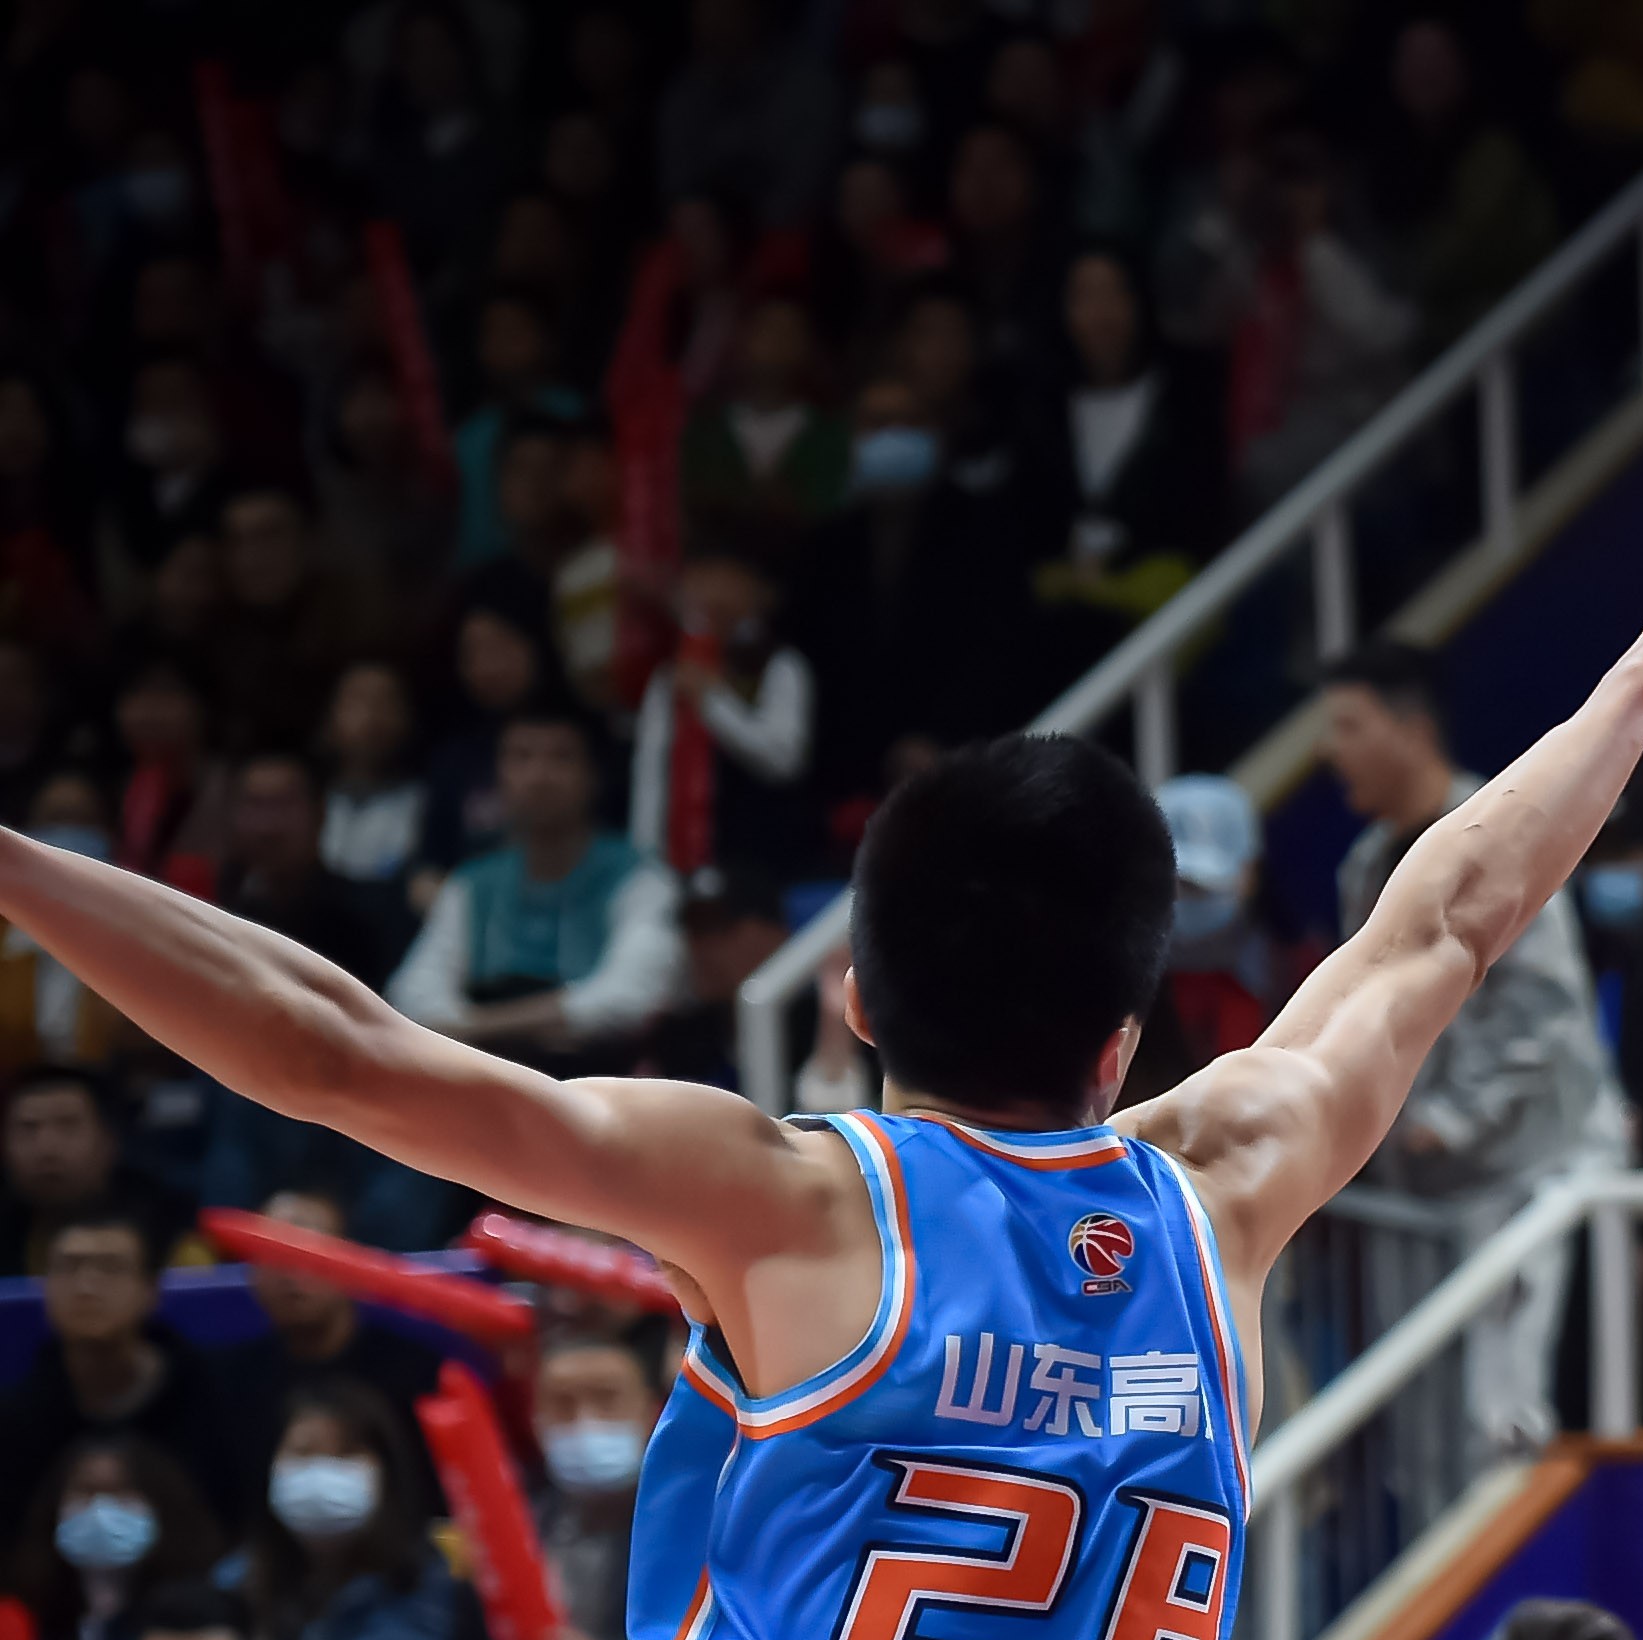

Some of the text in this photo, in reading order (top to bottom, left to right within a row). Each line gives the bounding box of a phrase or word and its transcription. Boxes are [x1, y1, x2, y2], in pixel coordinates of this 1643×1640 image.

[1083, 1278, 1132, 1296] CBA
[934, 1331, 1213, 1442] 山东高
